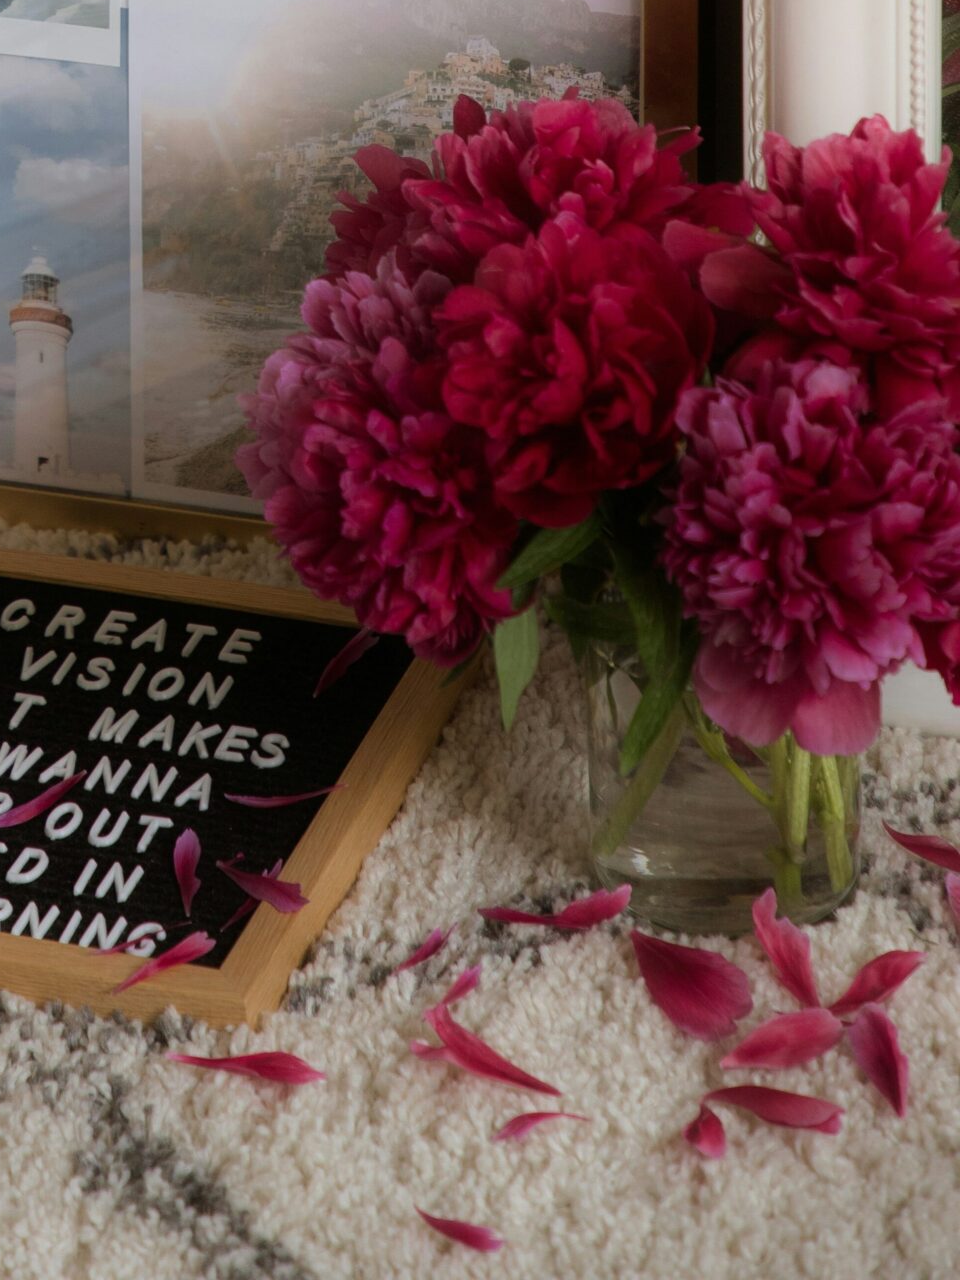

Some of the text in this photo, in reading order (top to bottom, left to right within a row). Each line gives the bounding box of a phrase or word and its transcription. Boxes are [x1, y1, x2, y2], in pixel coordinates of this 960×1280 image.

[0, 598, 262, 664] CREATE
[20, 646, 234, 710] VISION
[88, 707, 290, 770] MAKES
[45, 802, 174, 853] OUT
[73, 858, 144, 903] IN
